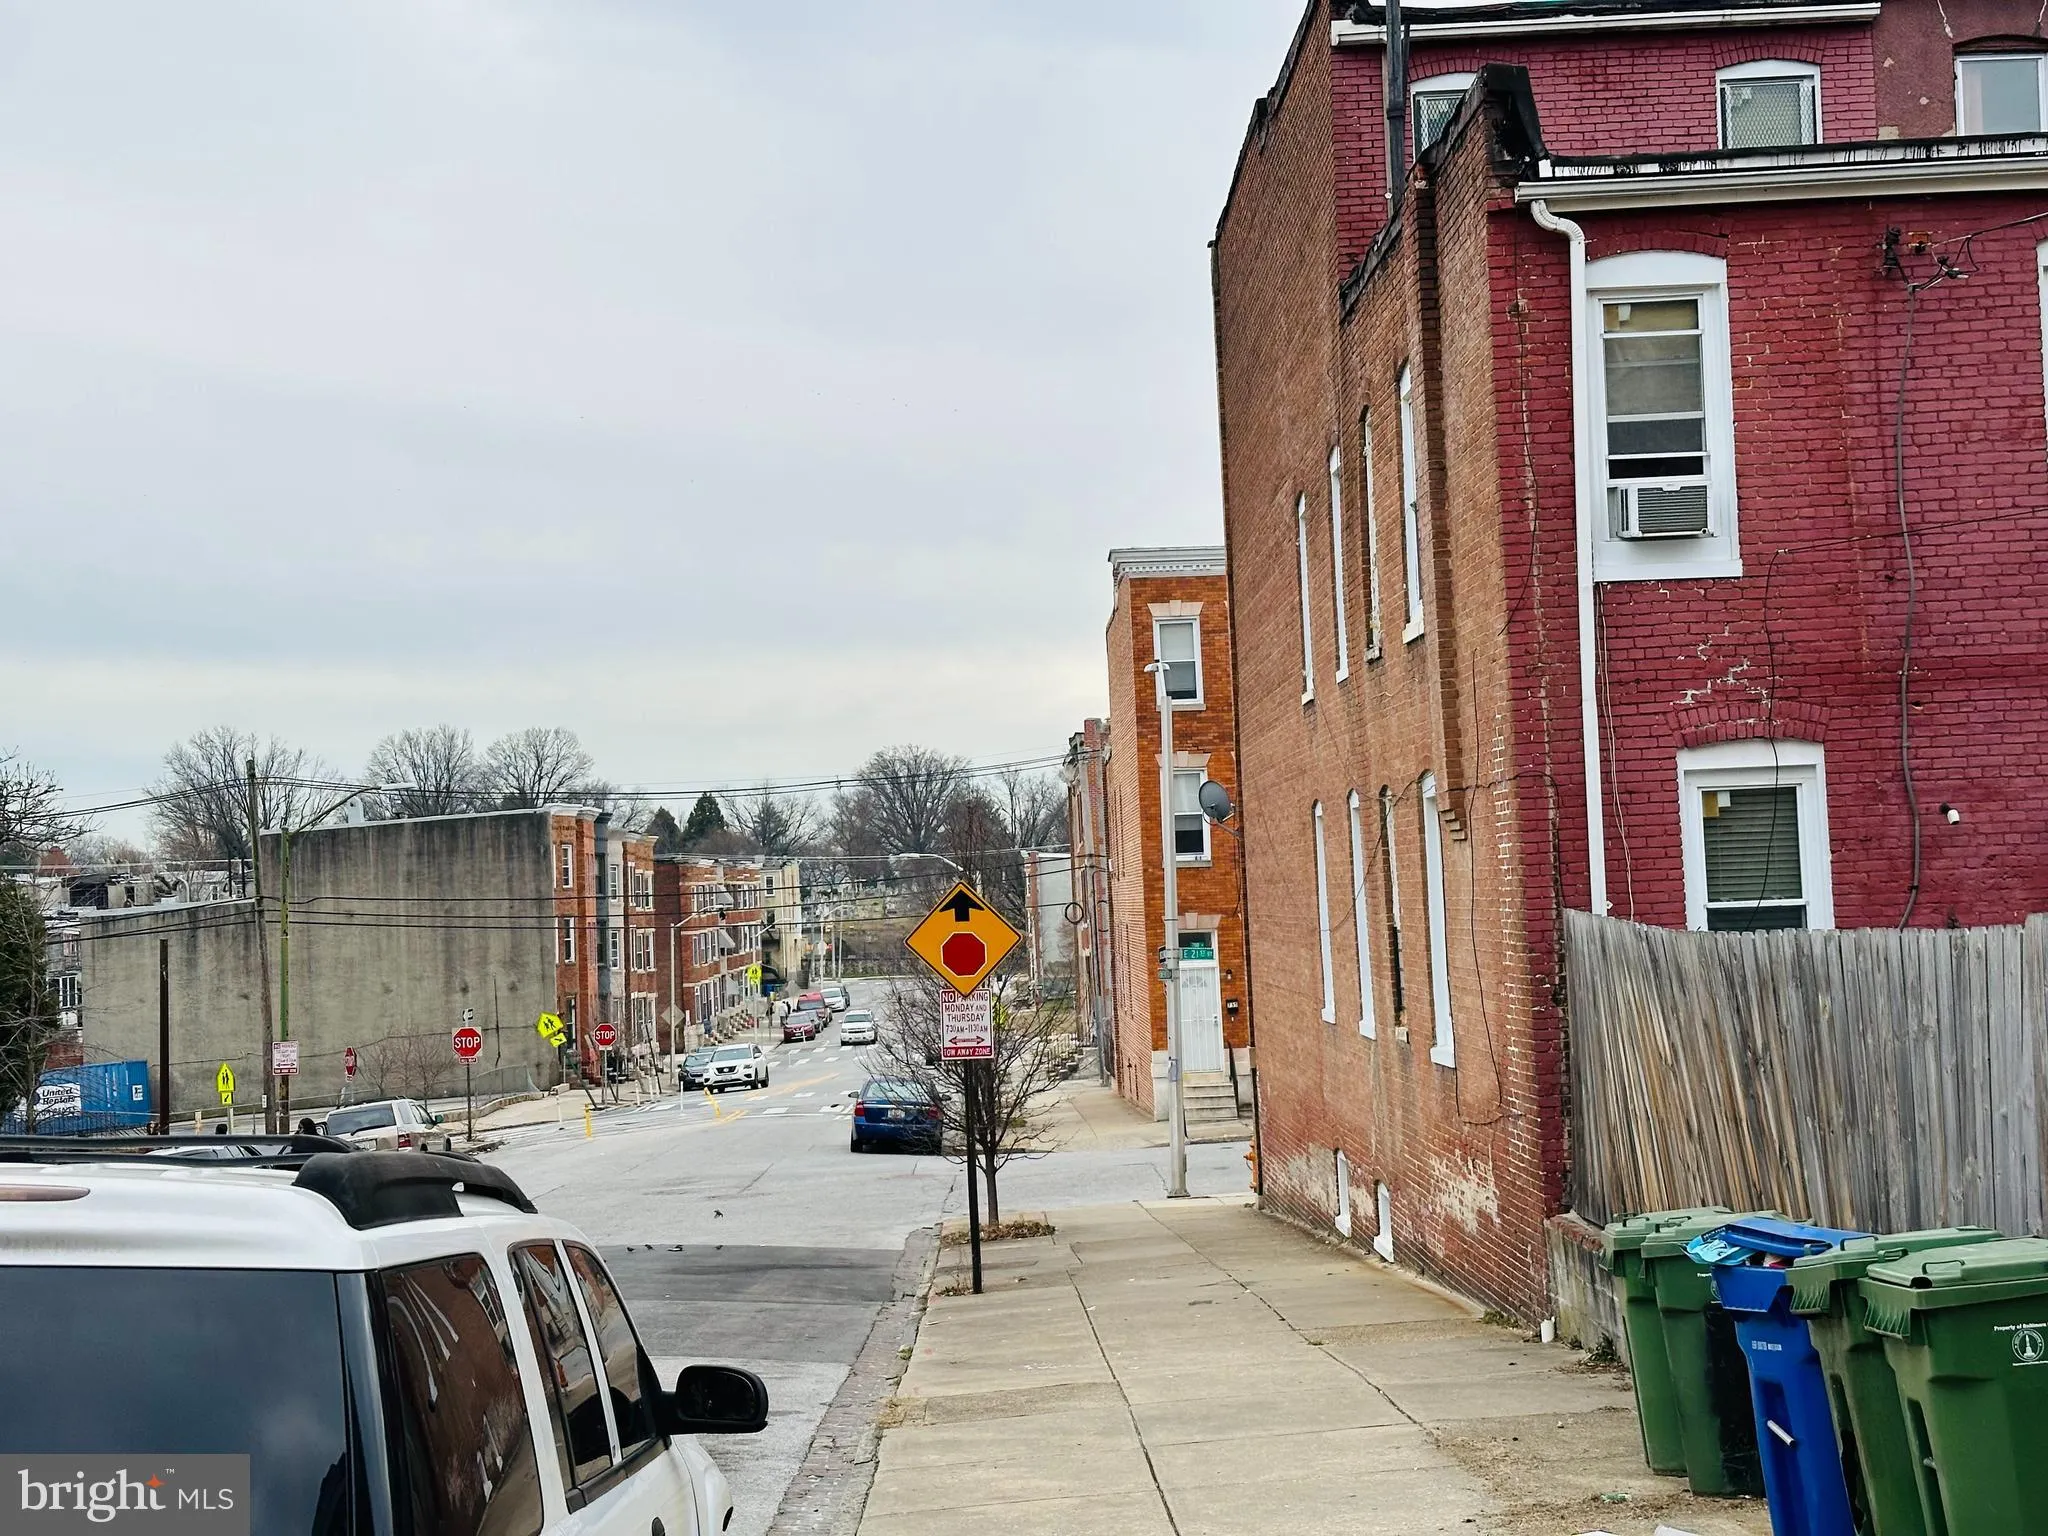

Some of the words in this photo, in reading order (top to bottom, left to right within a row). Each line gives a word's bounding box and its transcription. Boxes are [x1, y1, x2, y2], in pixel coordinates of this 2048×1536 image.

[943, 992, 954, 1002] NO
[944, 1003, 974, 1012] MONDAY
[947, 1013, 985, 1022] THURSDAY
[596, 1031, 615, 1040] STOP
[454, 1036, 480, 1048] STOP
[957, 1048, 974, 1056] AWAY
[975, 1047, 991, 1055] ZONE
[42, 1088, 72, 1097] United
